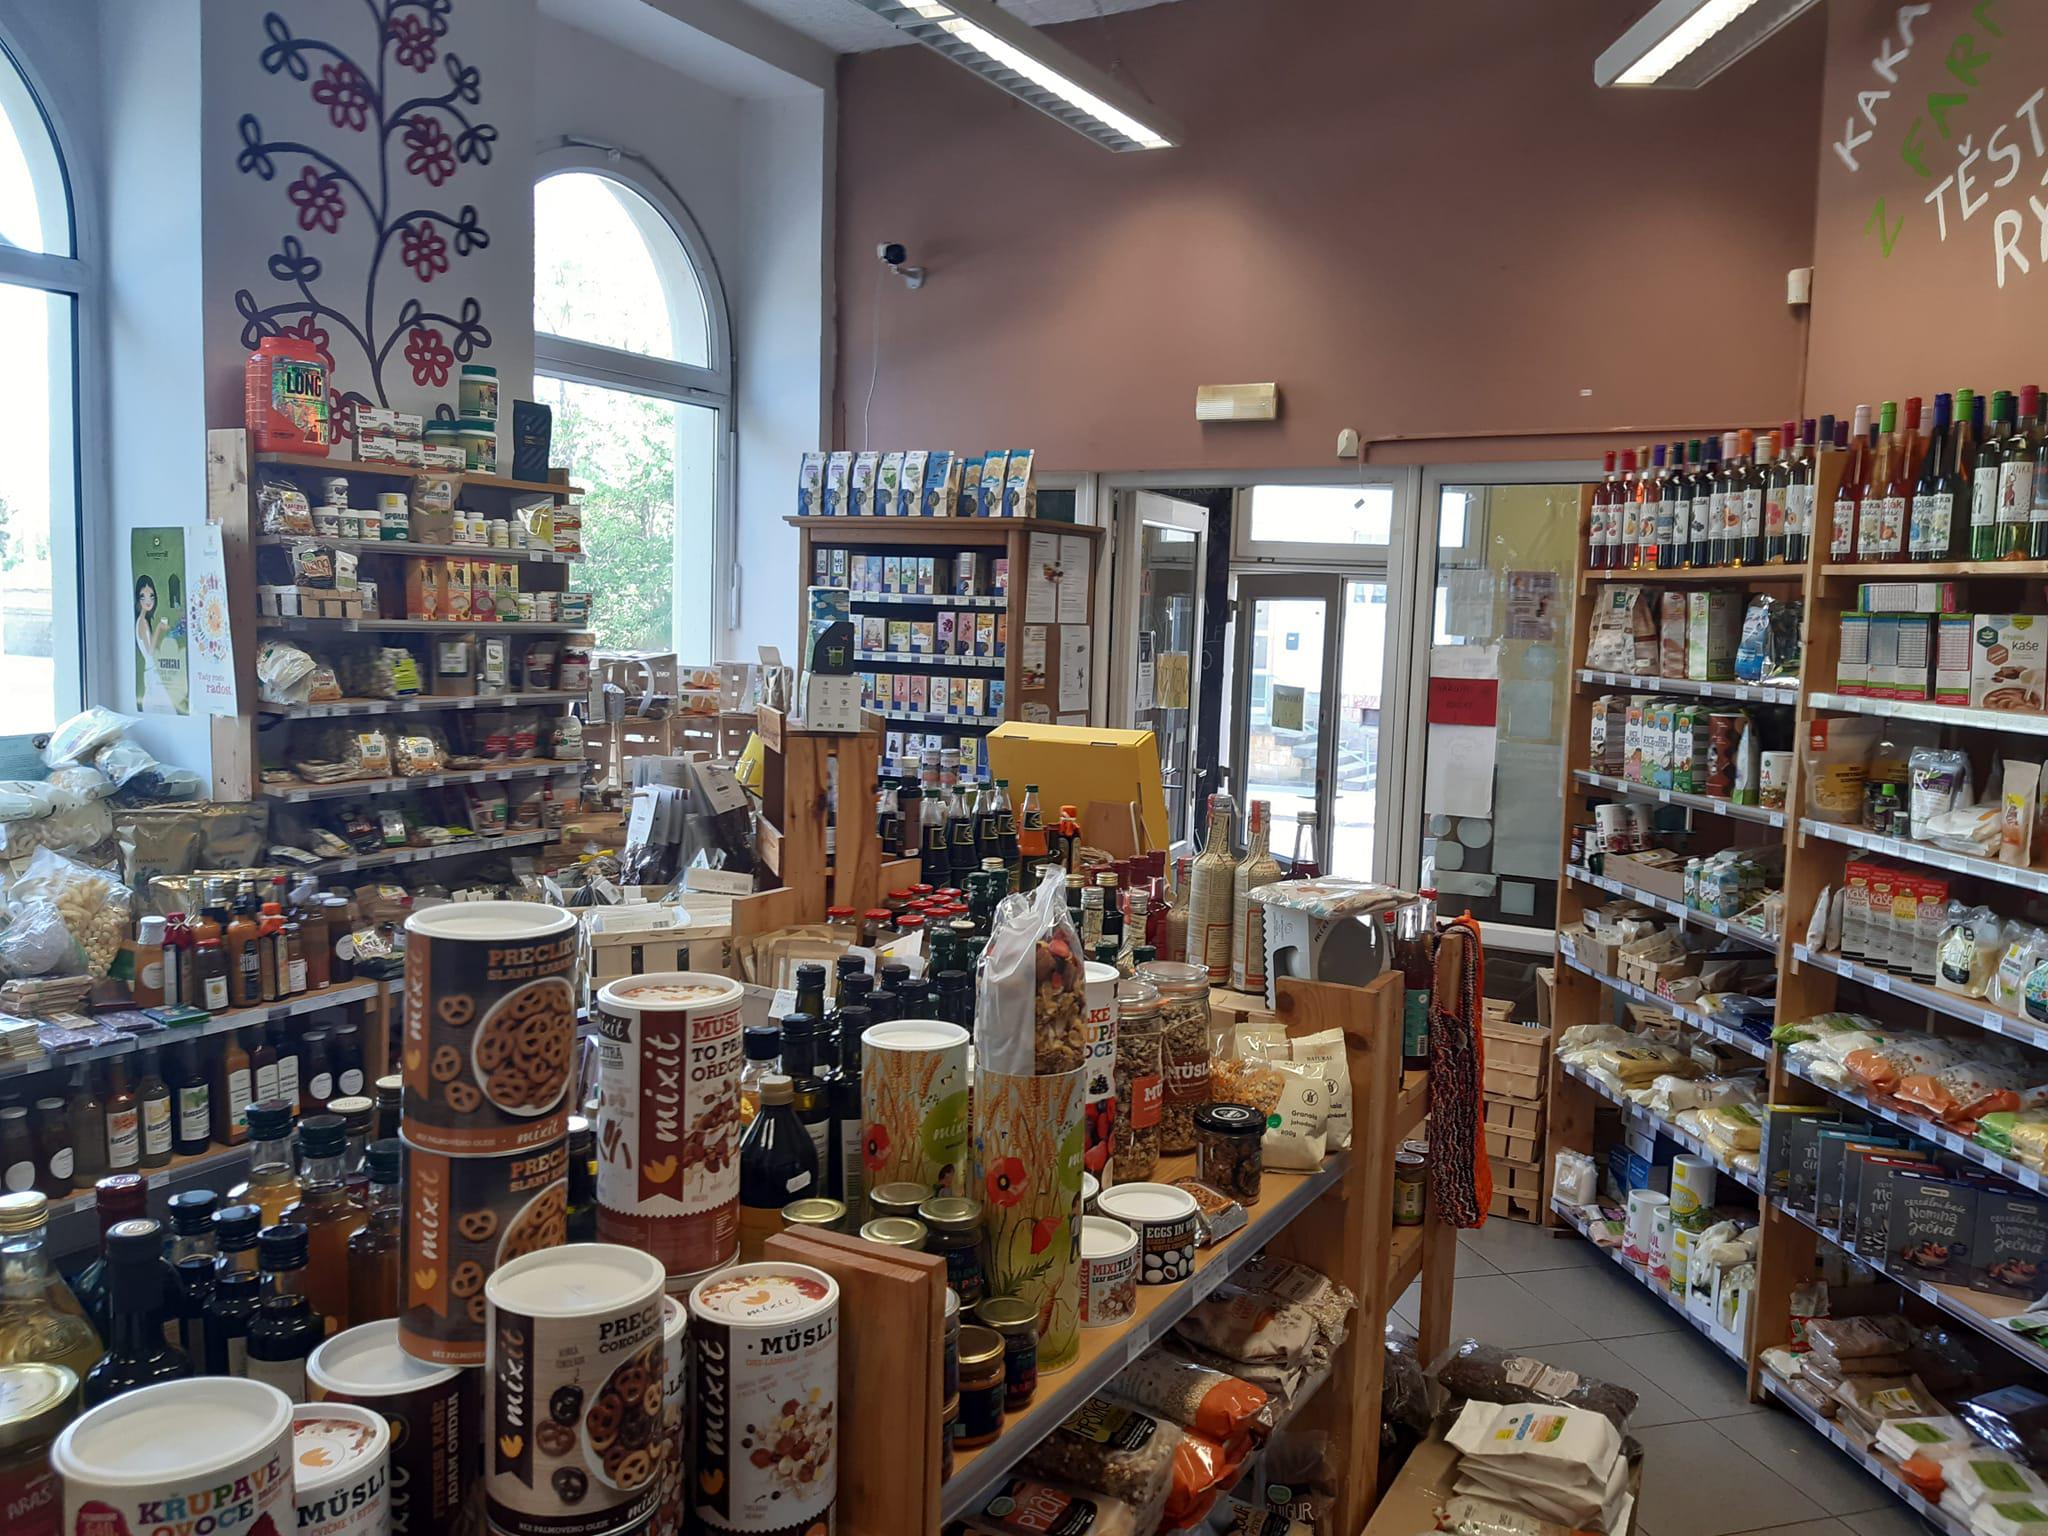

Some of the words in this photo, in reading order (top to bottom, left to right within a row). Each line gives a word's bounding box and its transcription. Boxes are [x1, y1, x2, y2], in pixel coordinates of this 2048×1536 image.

[286, 372, 322, 398] LONG
[692, 1045, 717, 1062] TO
[644, 1032, 680, 1142] mixit
[516, 1120, 559, 1144] mixit
[416, 1169, 440, 1260] mixit
[1146, 1225, 1173, 1239] EGGS
[1174, 1224, 1185, 1233] IN
[747, 1298, 793, 1316] mixit
[760, 1316, 833, 1356] MÜSLI
[502, 1327, 525, 1428] mixit
[698, 1338, 725, 1456] mixit
[138, 1450, 280, 1525] KŘUPAVÉ
[297, 1466, 385, 1528] MÜSLI
[152, 1498, 253, 1536] OVOCE
